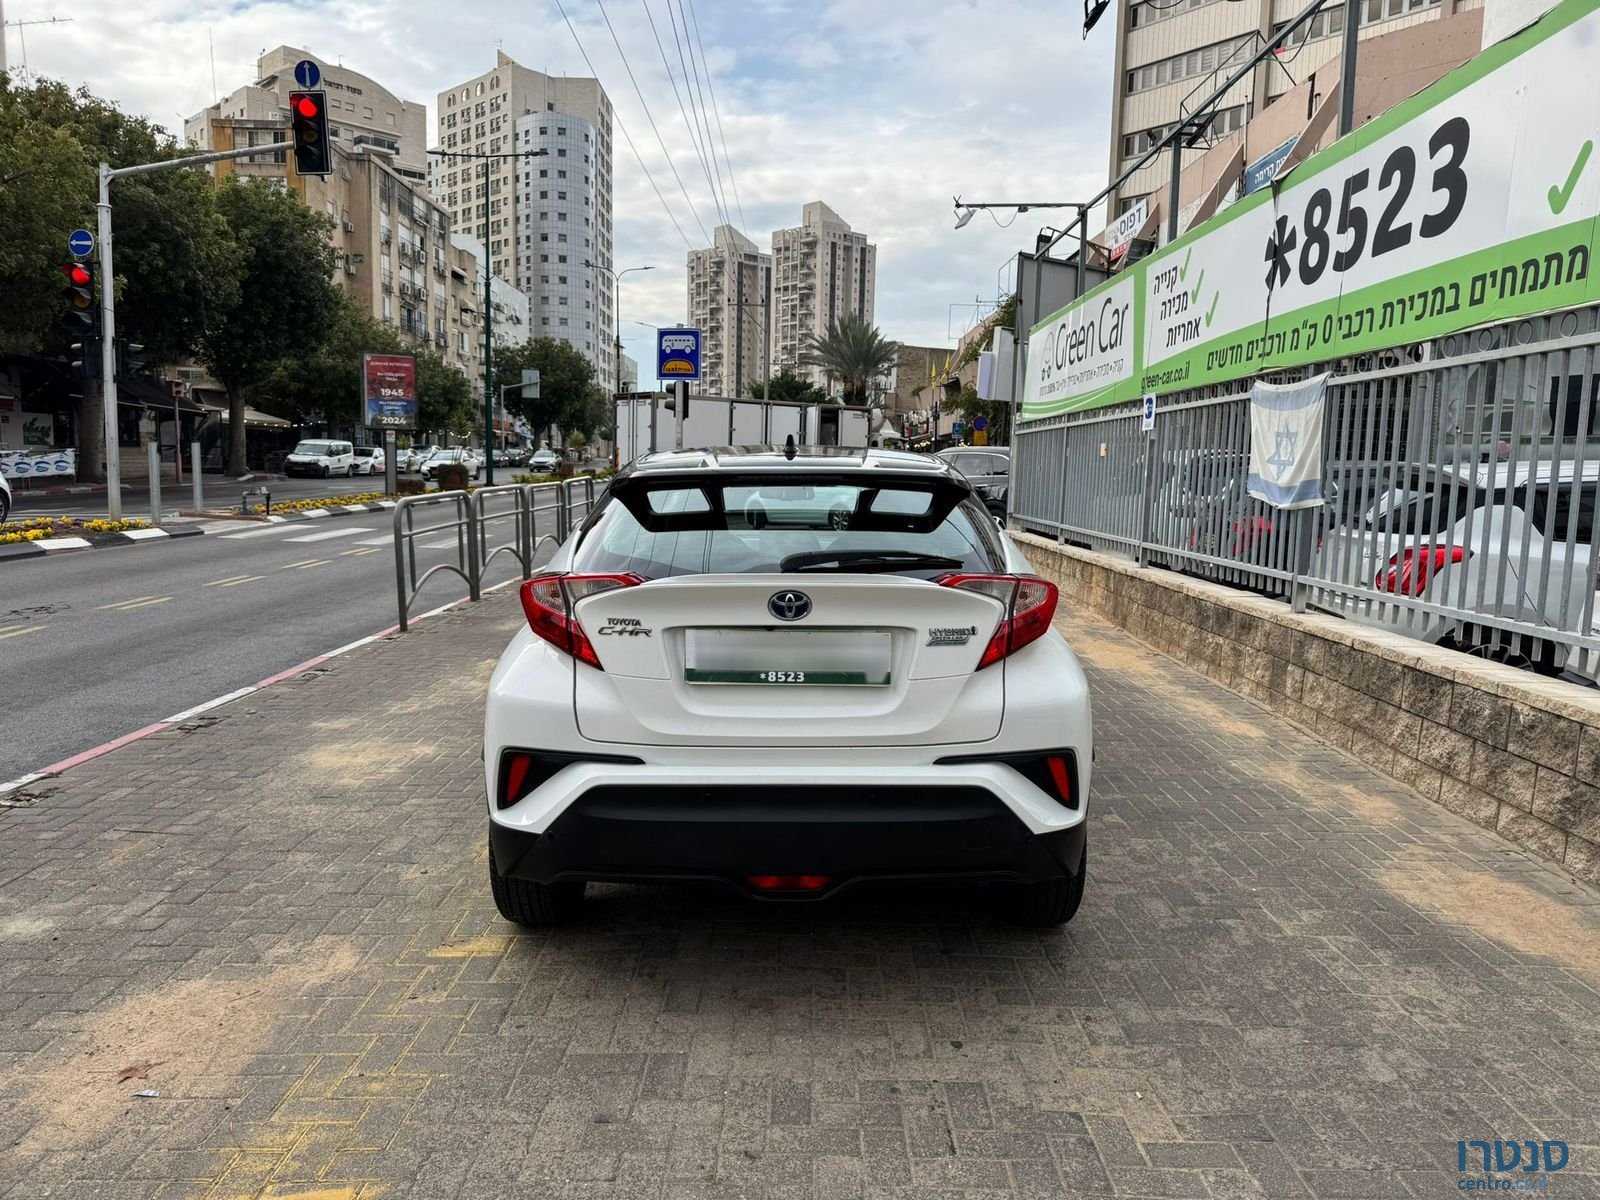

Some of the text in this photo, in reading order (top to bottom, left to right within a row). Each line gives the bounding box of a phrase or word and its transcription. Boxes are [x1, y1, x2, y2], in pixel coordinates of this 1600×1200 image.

[1119, 207, 1142, 235] דפוס
[1154, 266, 1178, 295] קנייה
[1469, 244, 1589, 307] מתמחים
[1160, 291, 1188, 320] מכירה
[1379, 282, 1460, 331] במכירת
[1055, 297, 1129, 371] Green Car
[1166, 317, 1201, 348] אחריות
[1322, 314, 1333, 344] 0
[1337, 307, 1375, 340] רכבי
[1207, 343, 1243, 371] חדשים
[1245, 331, 1287, 362] ורכבים
[380, 388, 404, 396] 1945
[1140, 360, 1191, 395] green-car.co.il
[382, 416, 407, 424] 2024
[598, 626, 653, 638] C-HR
[607, 617, 641, 626] TOYOTA
[928, 627, 970, 636] HYBRID
